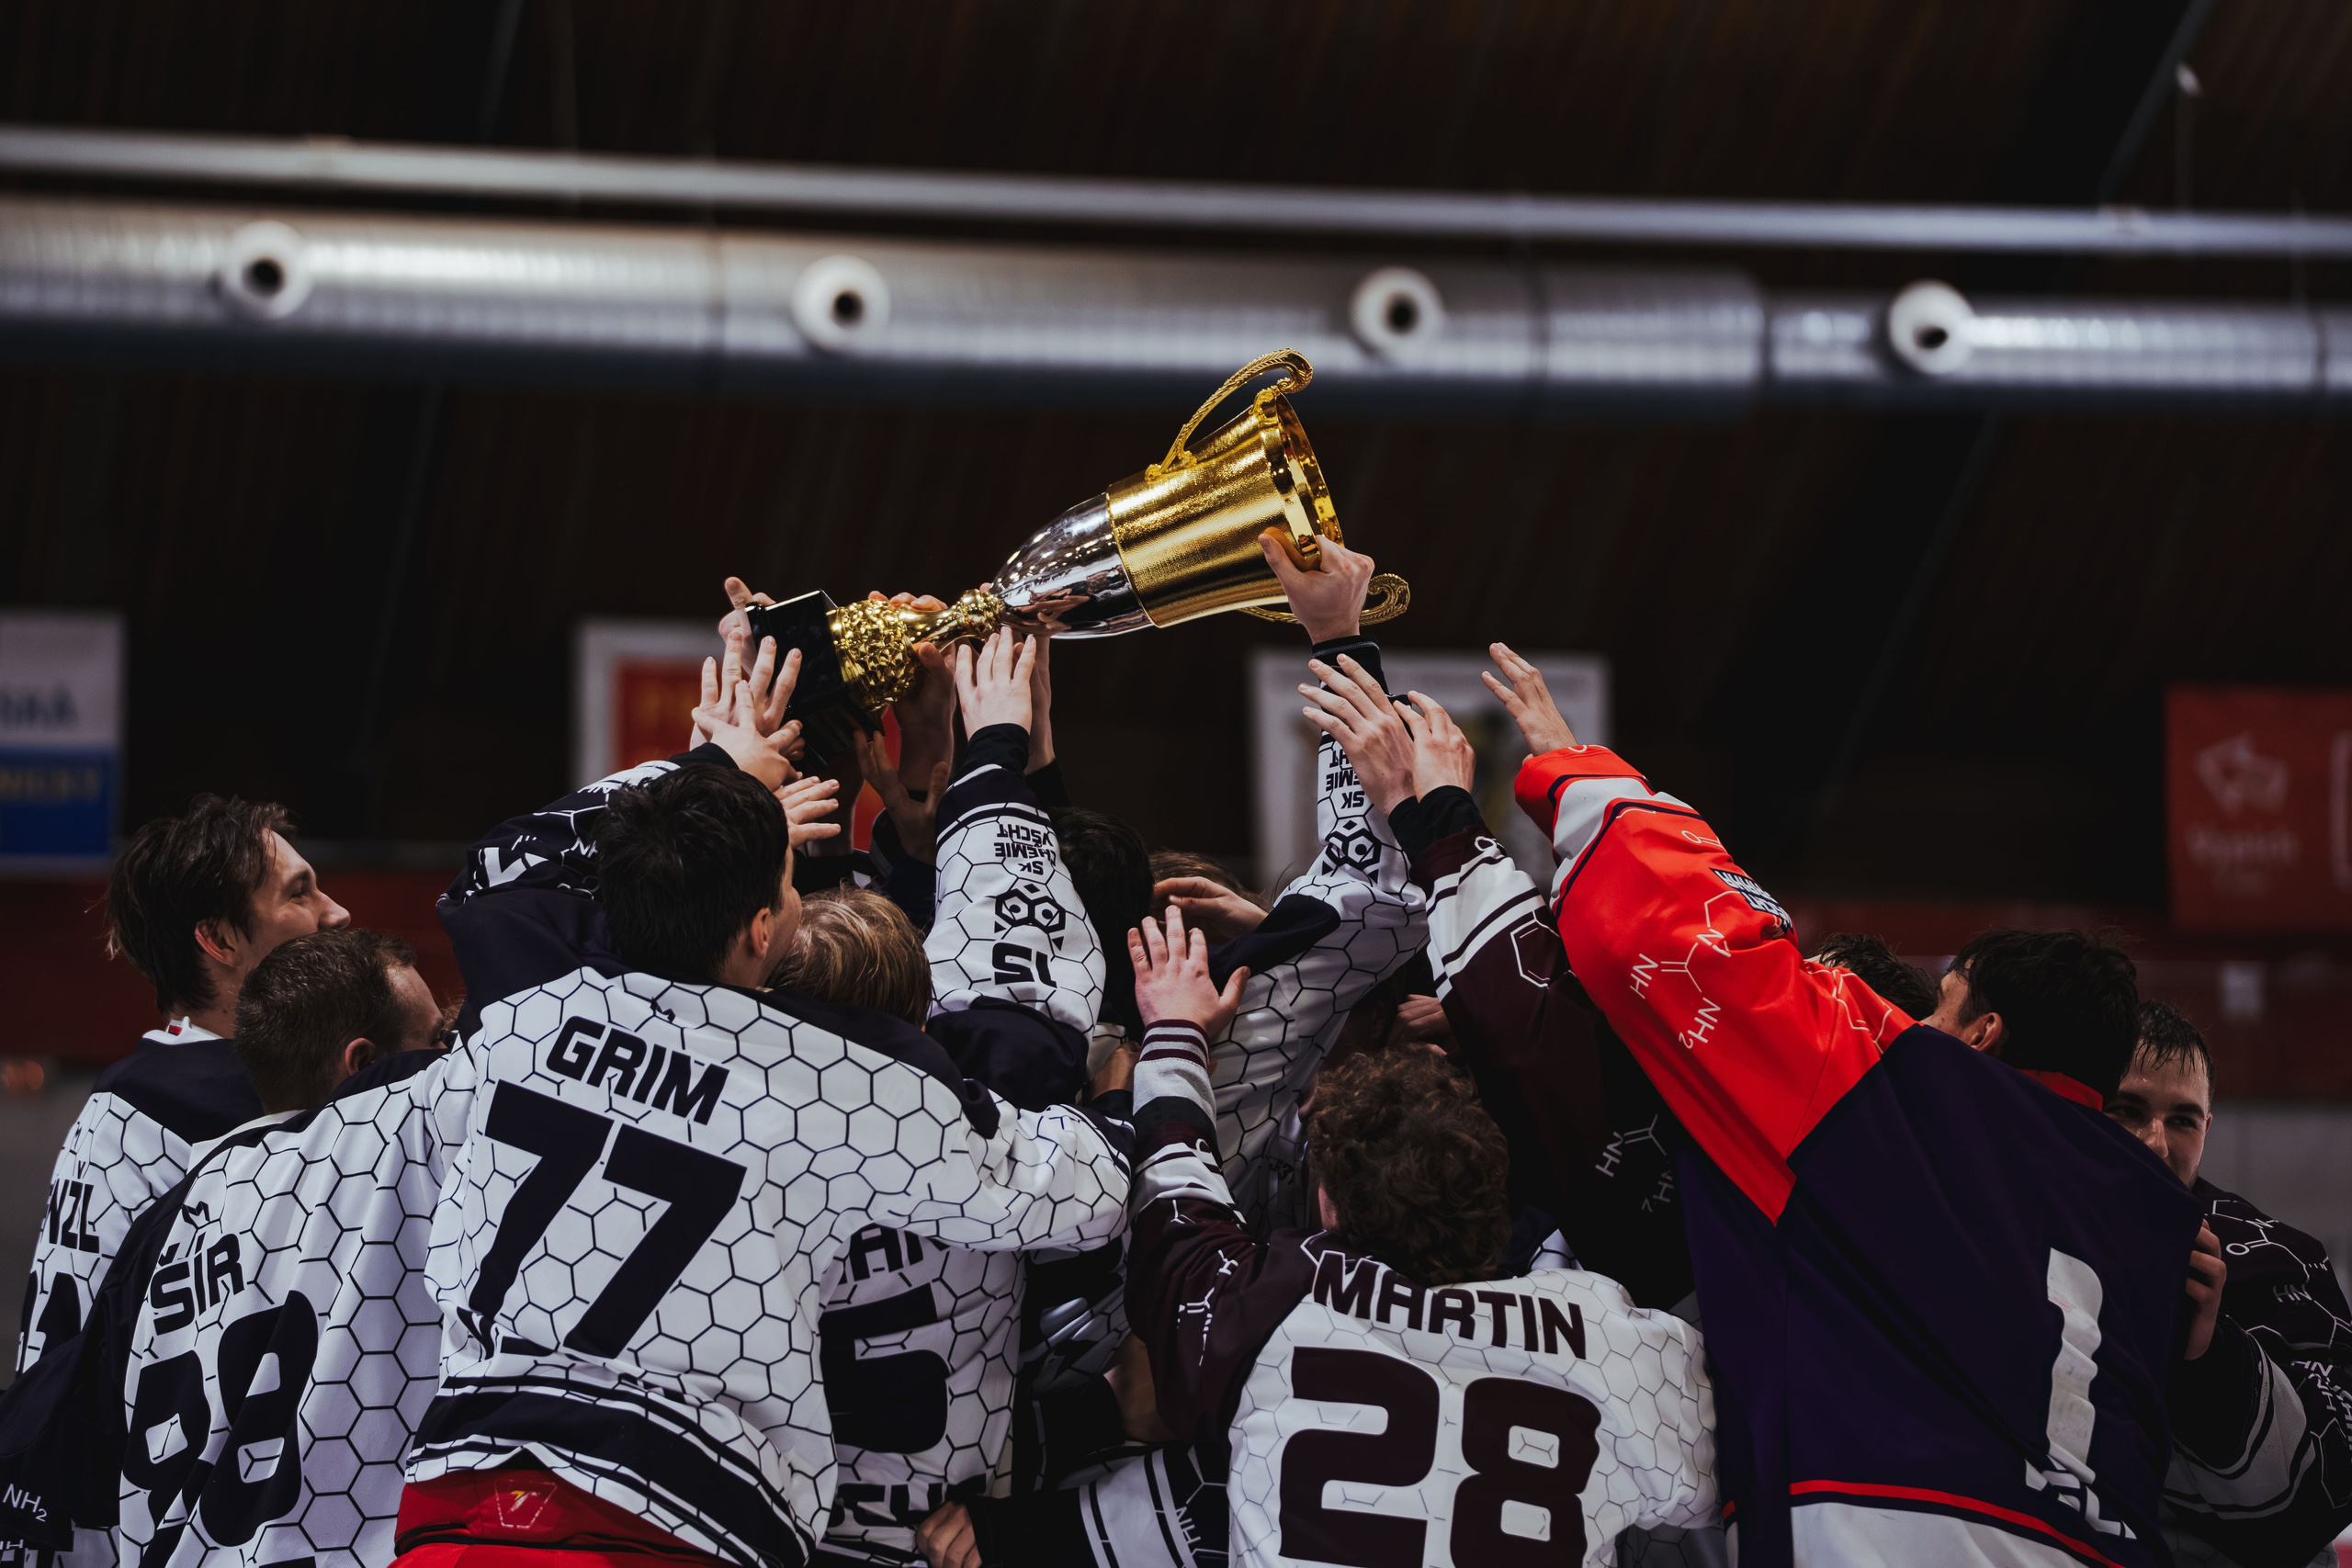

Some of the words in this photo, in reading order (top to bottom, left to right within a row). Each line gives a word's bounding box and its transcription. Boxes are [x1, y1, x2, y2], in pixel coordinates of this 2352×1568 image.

[1340, 790, 1365, 809] SK
[993, 841, 1057, 867] CHEMIE
[1018, 860, 1045, 875] SK
[991, 942, 1058, 989] 15
[546, 1015, 730, 1126] GRIM
[46, 1178, 100, 1254] NZL
[469, 1078, 748, 1359] 77
[1312, 1249, 1588, 1360] MARTIN
[2046, 1247, 2104, 1486] 1
[1278, 1345, 1602, 1568] 28
